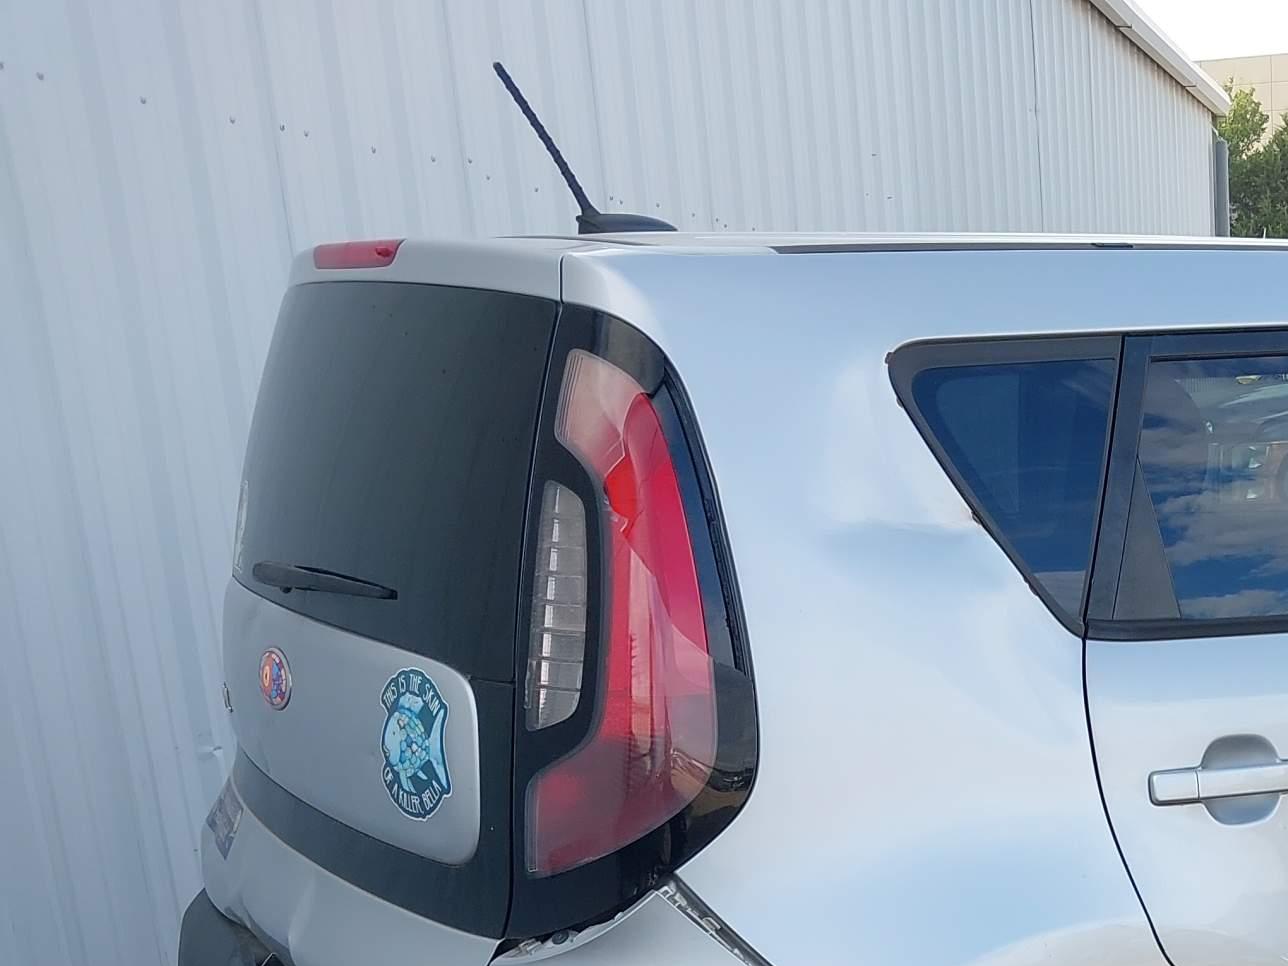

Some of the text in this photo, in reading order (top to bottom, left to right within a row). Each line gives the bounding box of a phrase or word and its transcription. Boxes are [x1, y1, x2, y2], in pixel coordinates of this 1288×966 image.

[383, 673, 441, 717] THIS IS THE SKIN
[383, 766, 394, 785] OF
[399, 788, 425, 814] KILLER
[421, 779, 442, 811] BELLA
